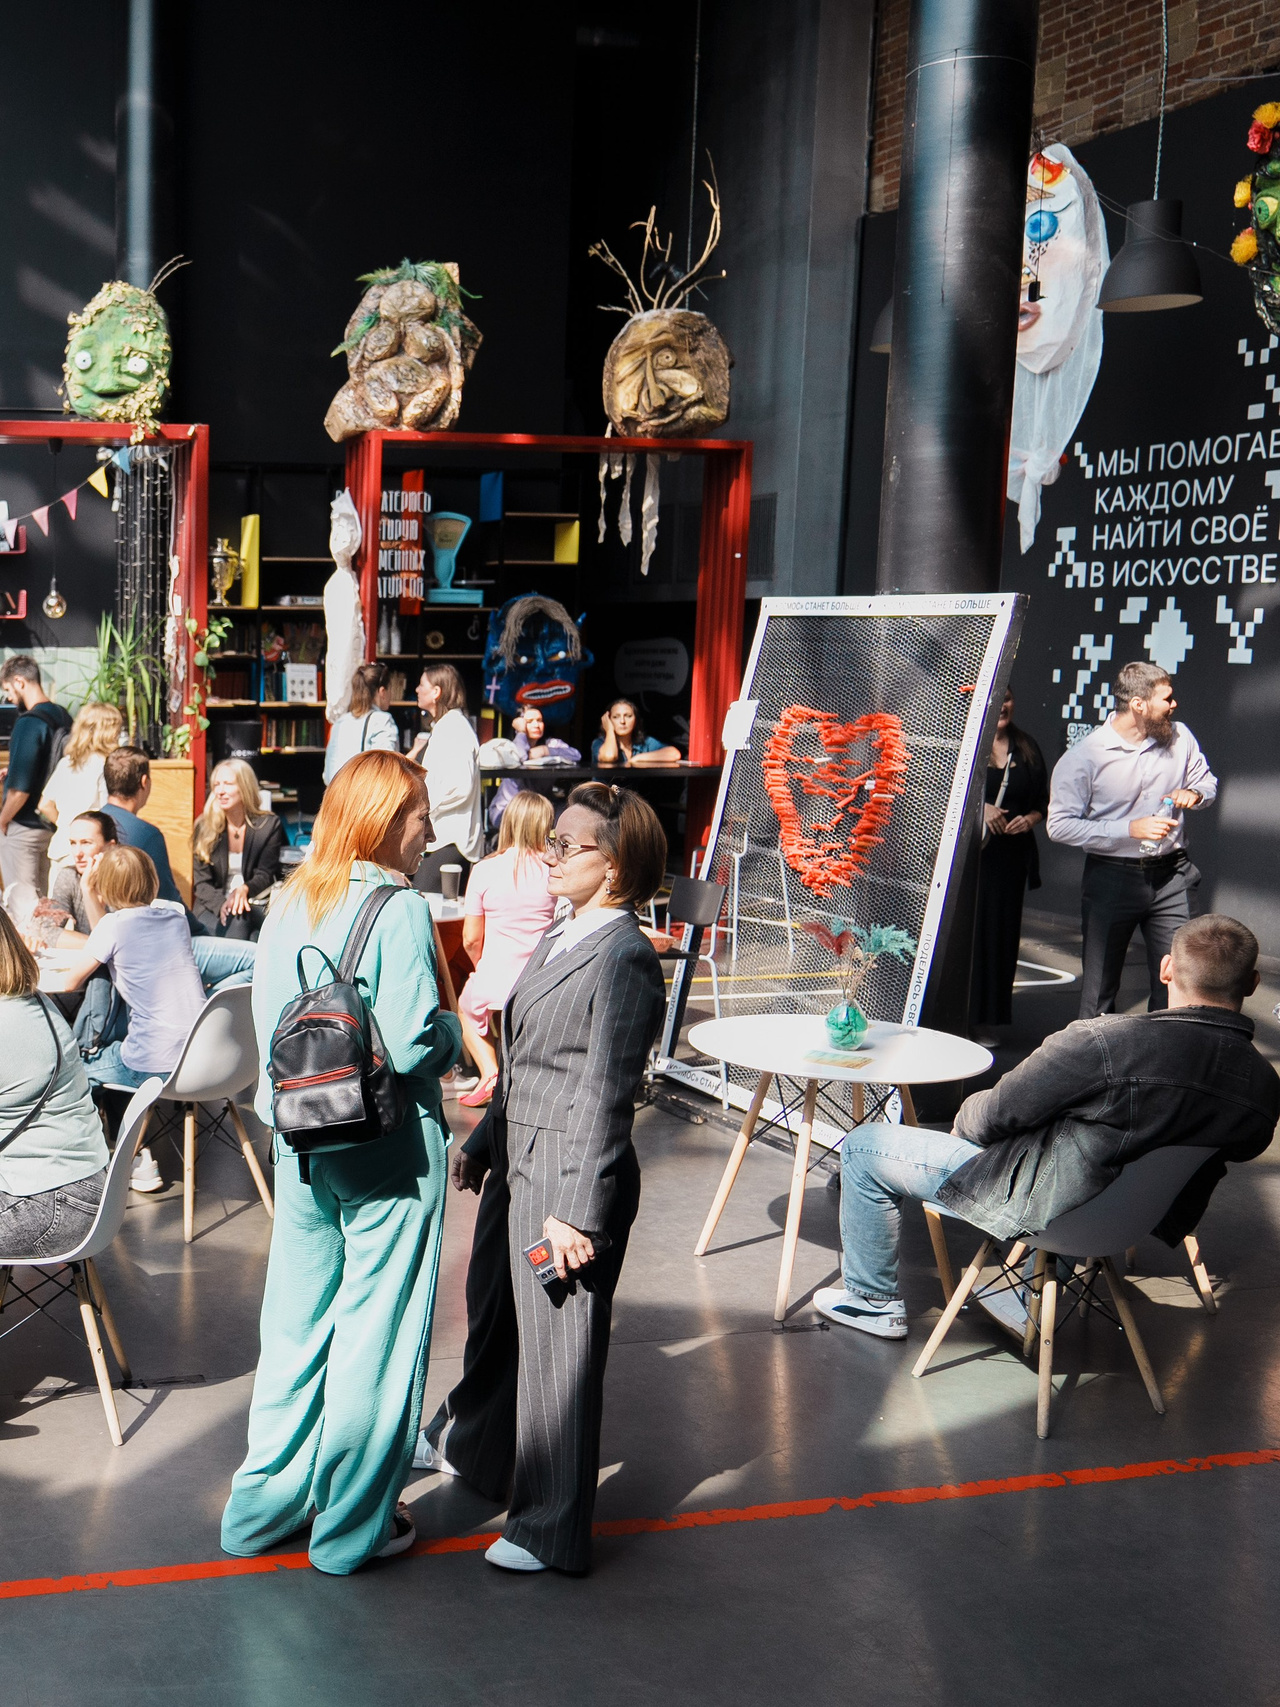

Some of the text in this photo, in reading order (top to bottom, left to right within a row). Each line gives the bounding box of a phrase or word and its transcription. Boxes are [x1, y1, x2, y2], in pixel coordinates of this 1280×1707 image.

[1097, 428, 1280, 477] МЫ ПОМОГАЕ
[381, 490, 431, 513] АТЕРЮСЬ
[1095, 474, 1235, 515] КАЖДОМУ
[379, 519, 418, 542] ТИРУЮ
[1092, 504, 1269, 551] НАЙТИ СВОЁ
[378, 549, 426, 571] МЕННЫХ
[1089, 553, 1278, 588] В ИСКУССТВЕ
[377, 577, 424, 599] АТУРГОВ
[804, 601, 830, 611] СТАНЕТ
[954, 599, 992, 610] БОЛЬШЕ
[906, 933, 932, 1026] ПОДЕЛИСЬ СВО
